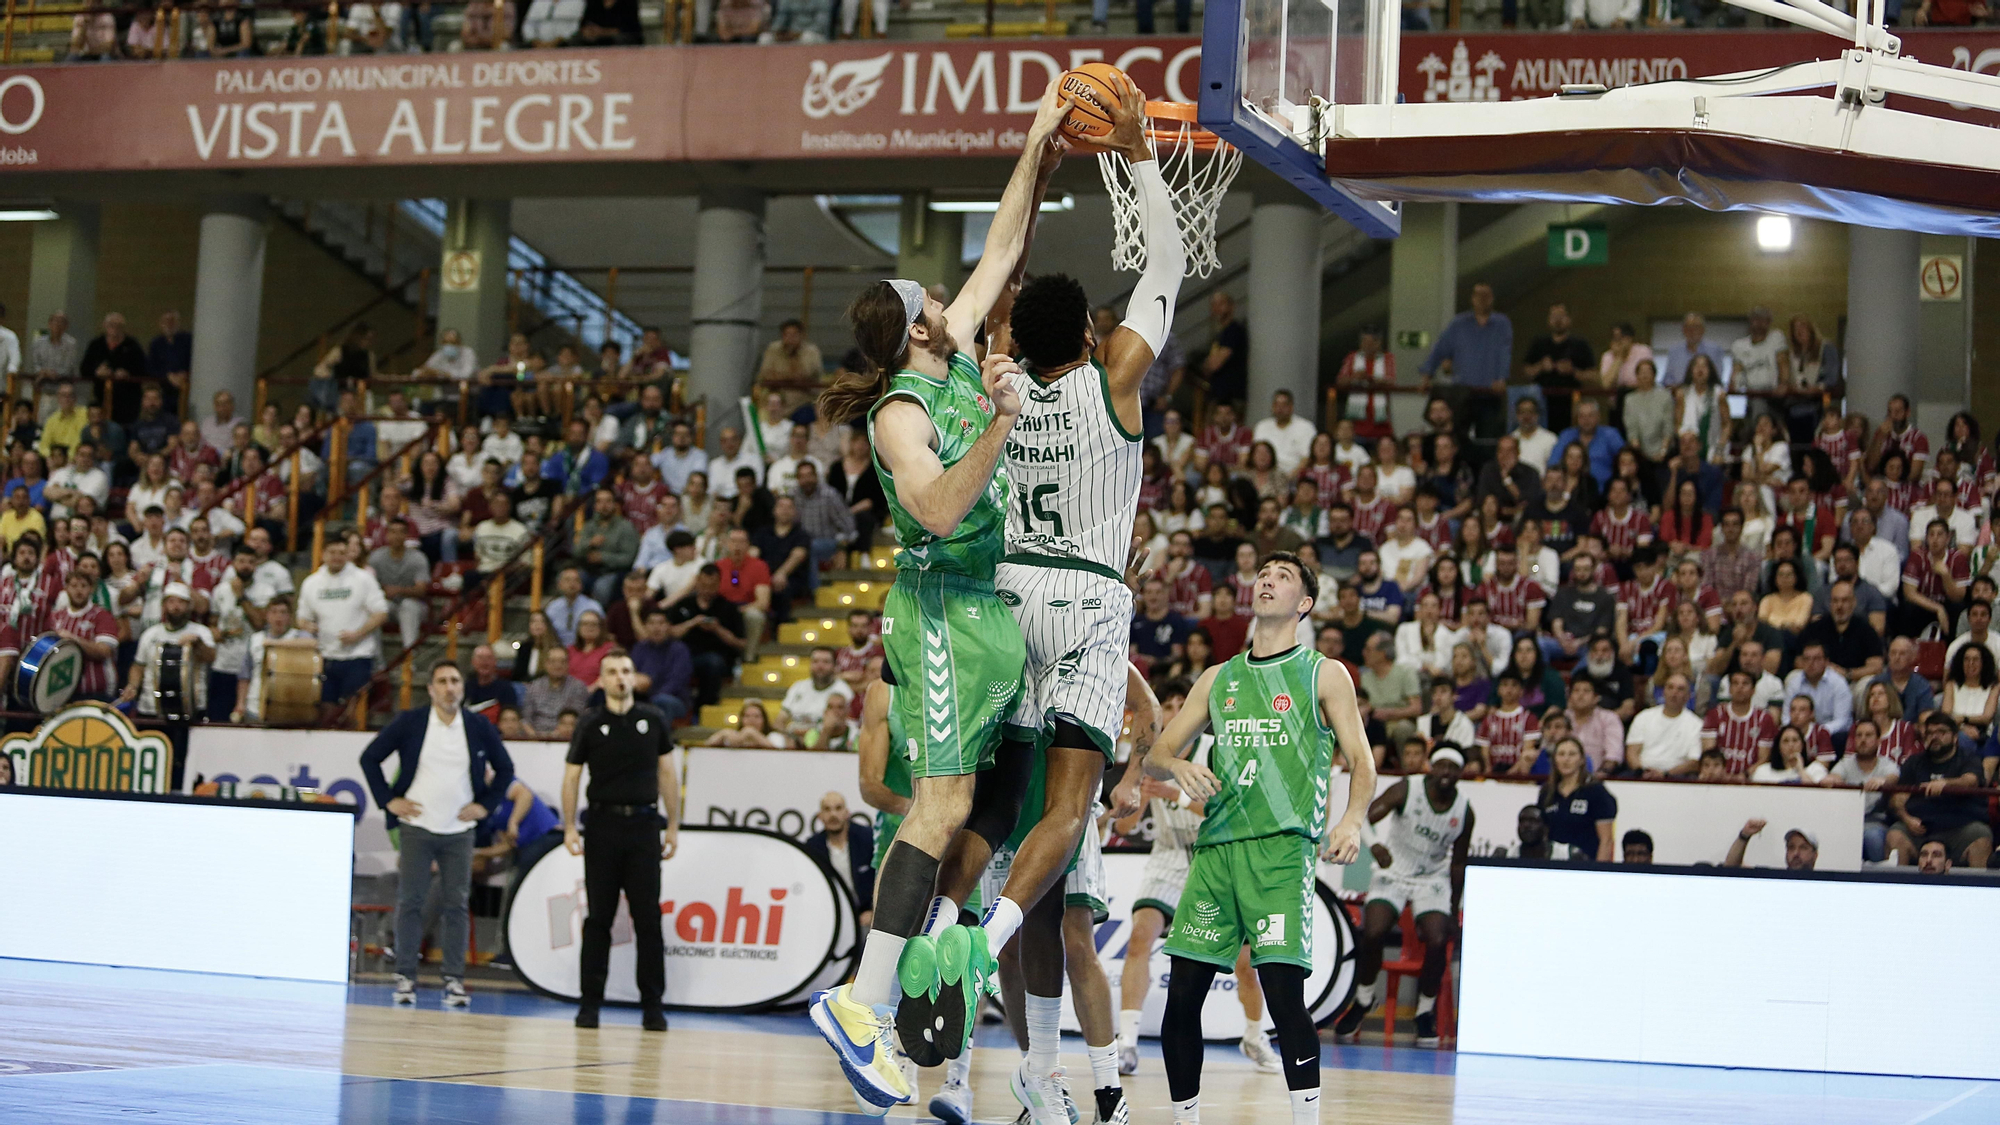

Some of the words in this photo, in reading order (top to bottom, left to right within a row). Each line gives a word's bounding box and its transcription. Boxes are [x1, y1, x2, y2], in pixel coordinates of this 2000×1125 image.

[215, 67, 322, 94] PALACIO
[327, 64, 464, 91] MUNICIPAL
[472, 59, 601, 88] DEPORTES
[1510, 57, 1688, 92] AYUNTAMIENTO
[187, 101, 356, 160] VISTA
[378, 92, 635, 155] ALEGRE
[801, 130, 887, 150] Instituto
[890, 128, 995, 153] Municipal
[1564, 229, 1590, 260] D
[1018, 483, 1064, 537] 15
[1082, 598, 1102, 607] PRO
[1217, 731, 1289, 747] CASTELLÓ
[1225, 719, 1282, 734] AMICS
[1238, 759, 1257, 788] 4
[1181, 922, 1221, 942] ibertic
